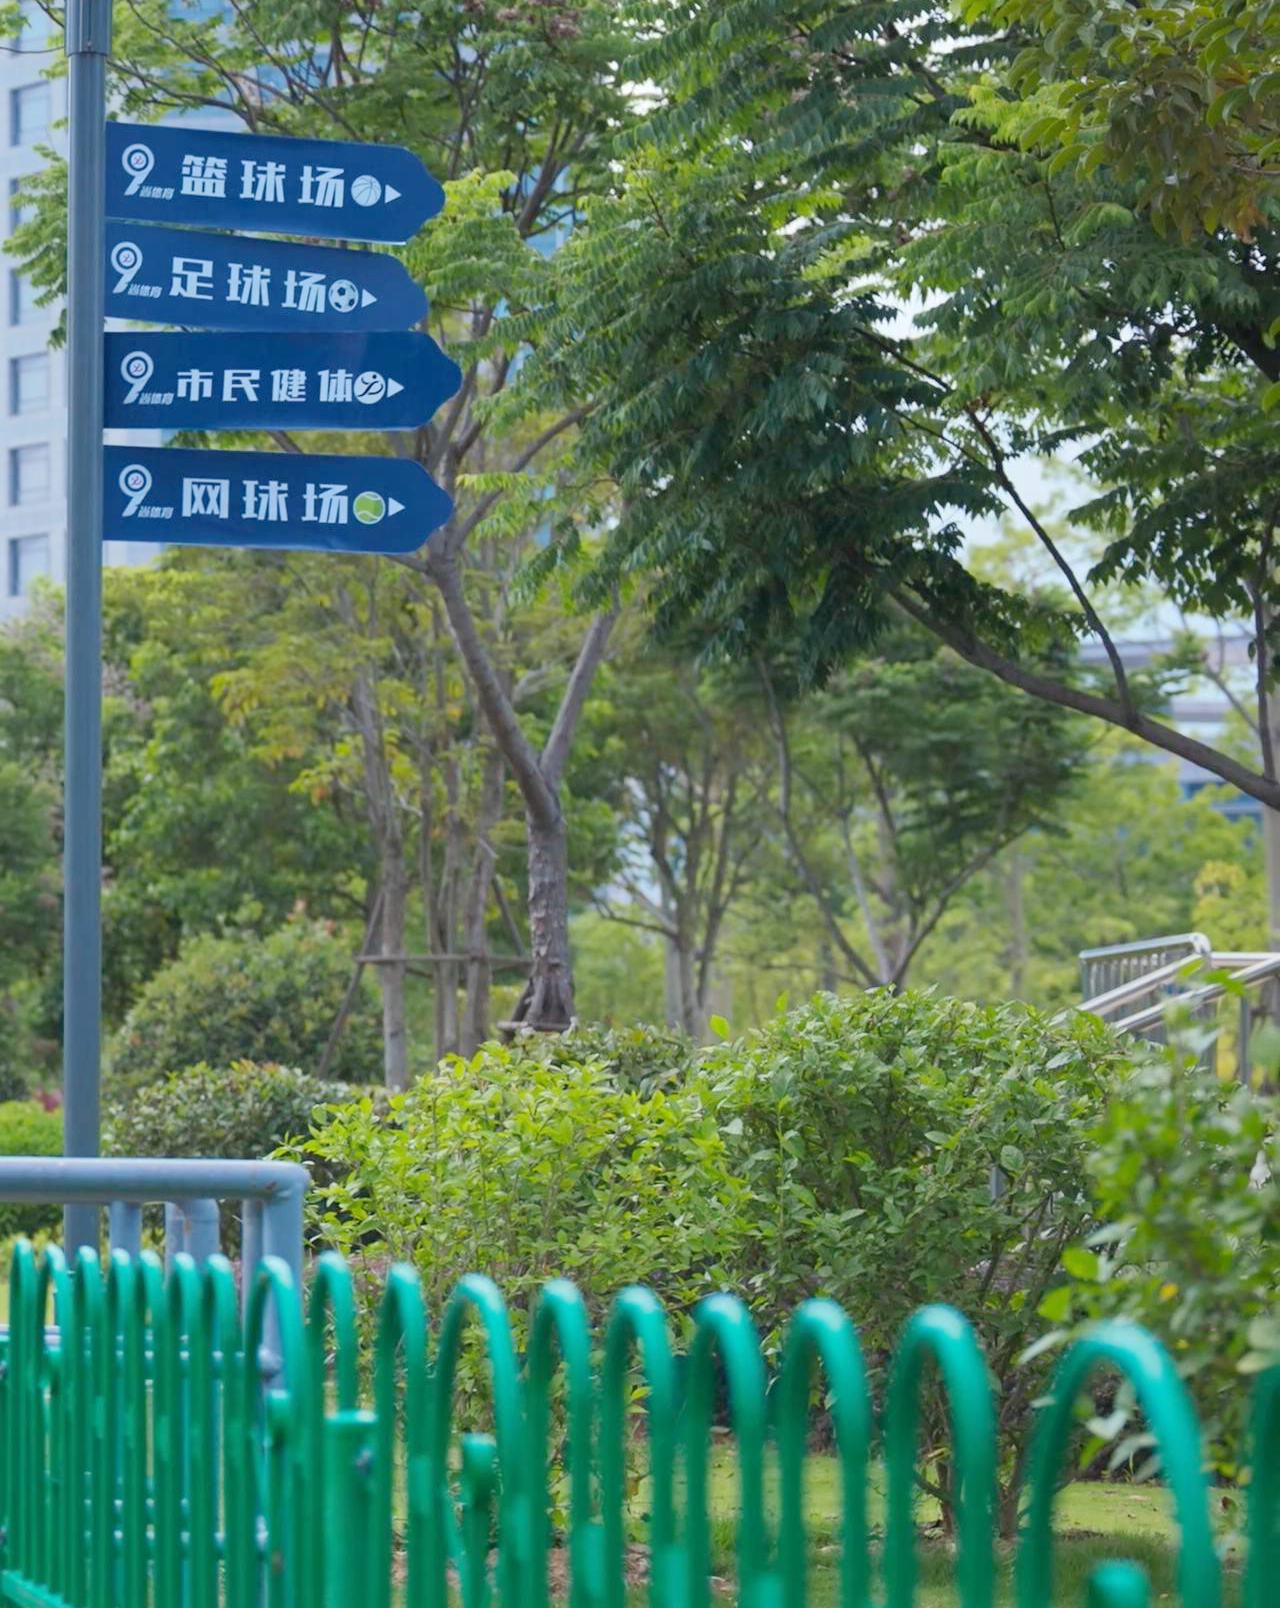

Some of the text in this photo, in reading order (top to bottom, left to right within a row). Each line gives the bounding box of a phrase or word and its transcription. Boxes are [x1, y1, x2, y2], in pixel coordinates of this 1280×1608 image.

[180, 154, 345, 208] 篮球场
[169, 256, 327, 313] 足球场
[177, 368, 353, 402] 市民健体
[182, 477, 349, 524] 网球场
